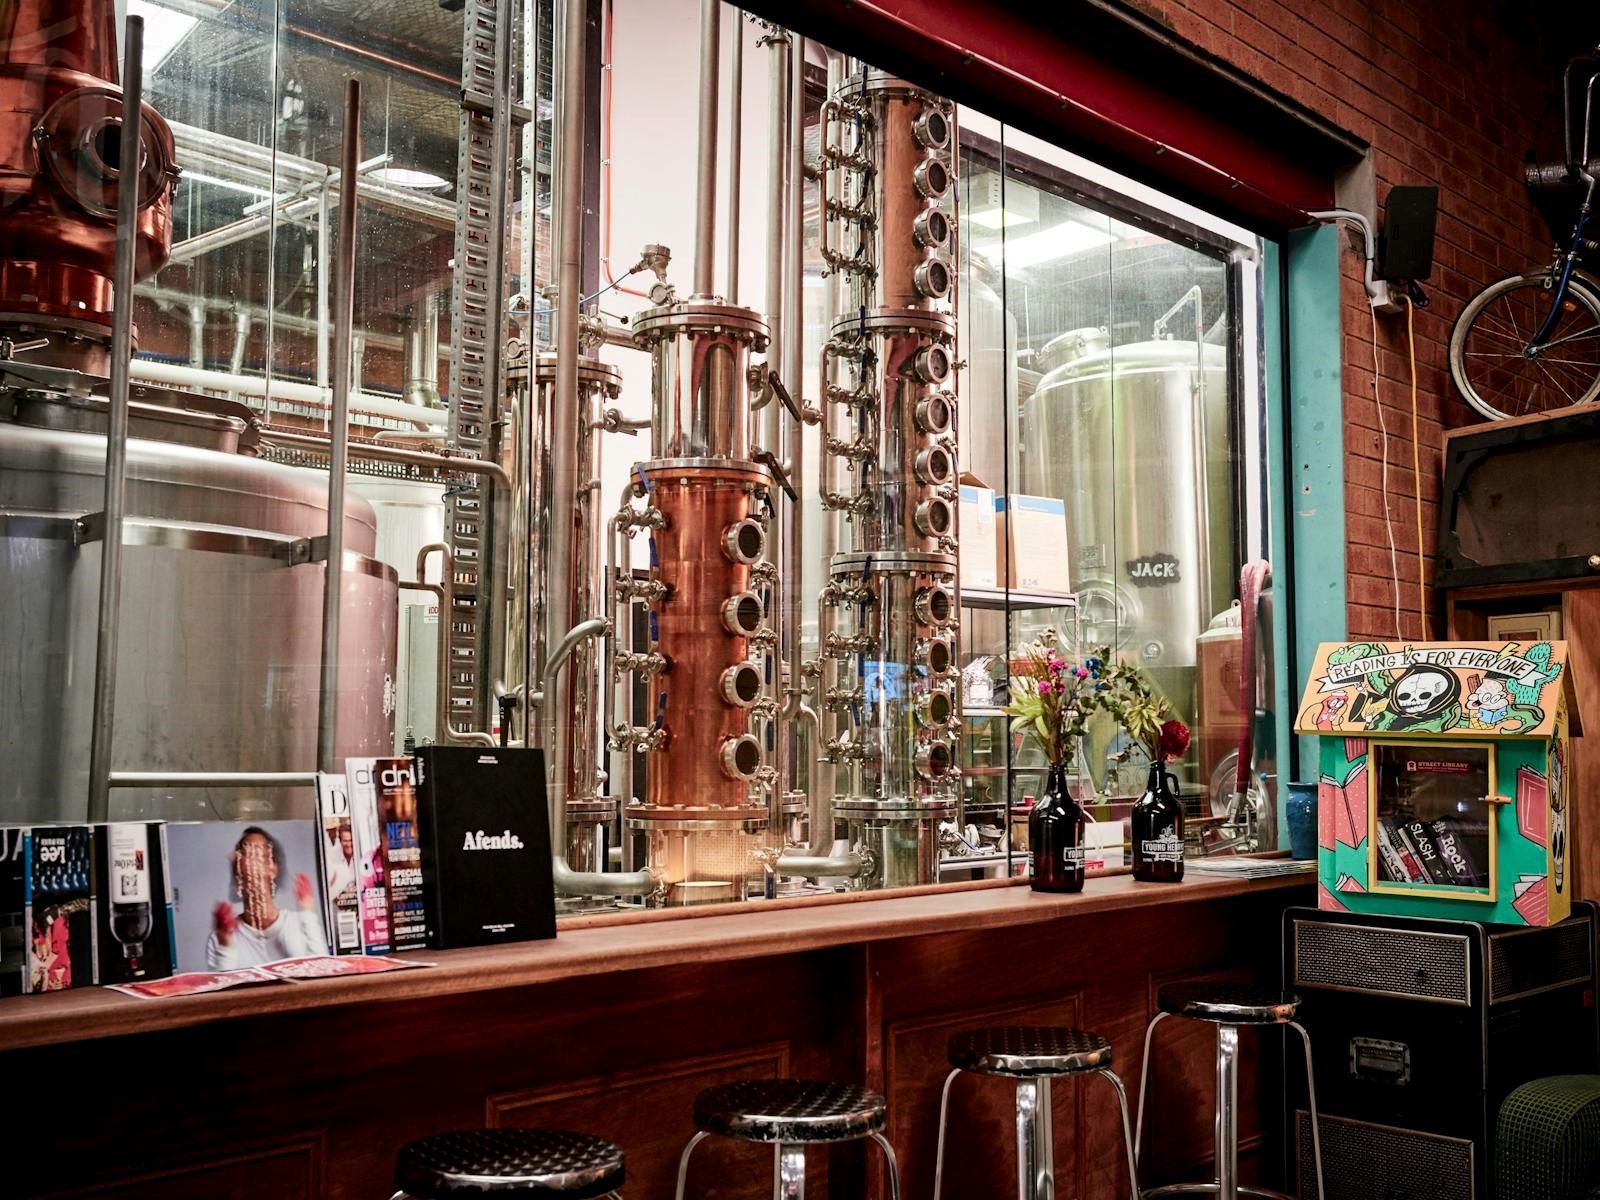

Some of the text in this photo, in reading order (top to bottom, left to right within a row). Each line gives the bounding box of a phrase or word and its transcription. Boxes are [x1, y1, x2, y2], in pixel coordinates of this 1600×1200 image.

[1132, 563, 1176, 577] JACK
[1334, 654, 1396, 679] READING
[1427, 651, 1456, 666] FOR
[1460, 651, 1531, 677] EVERYONE
[463, 830, 524, 850] Afends.
[1145, 843, 1166, 852] YOUNG
[1410, 823, 1436, 861] SLASH
[41, 846, 66, 864] Lee
